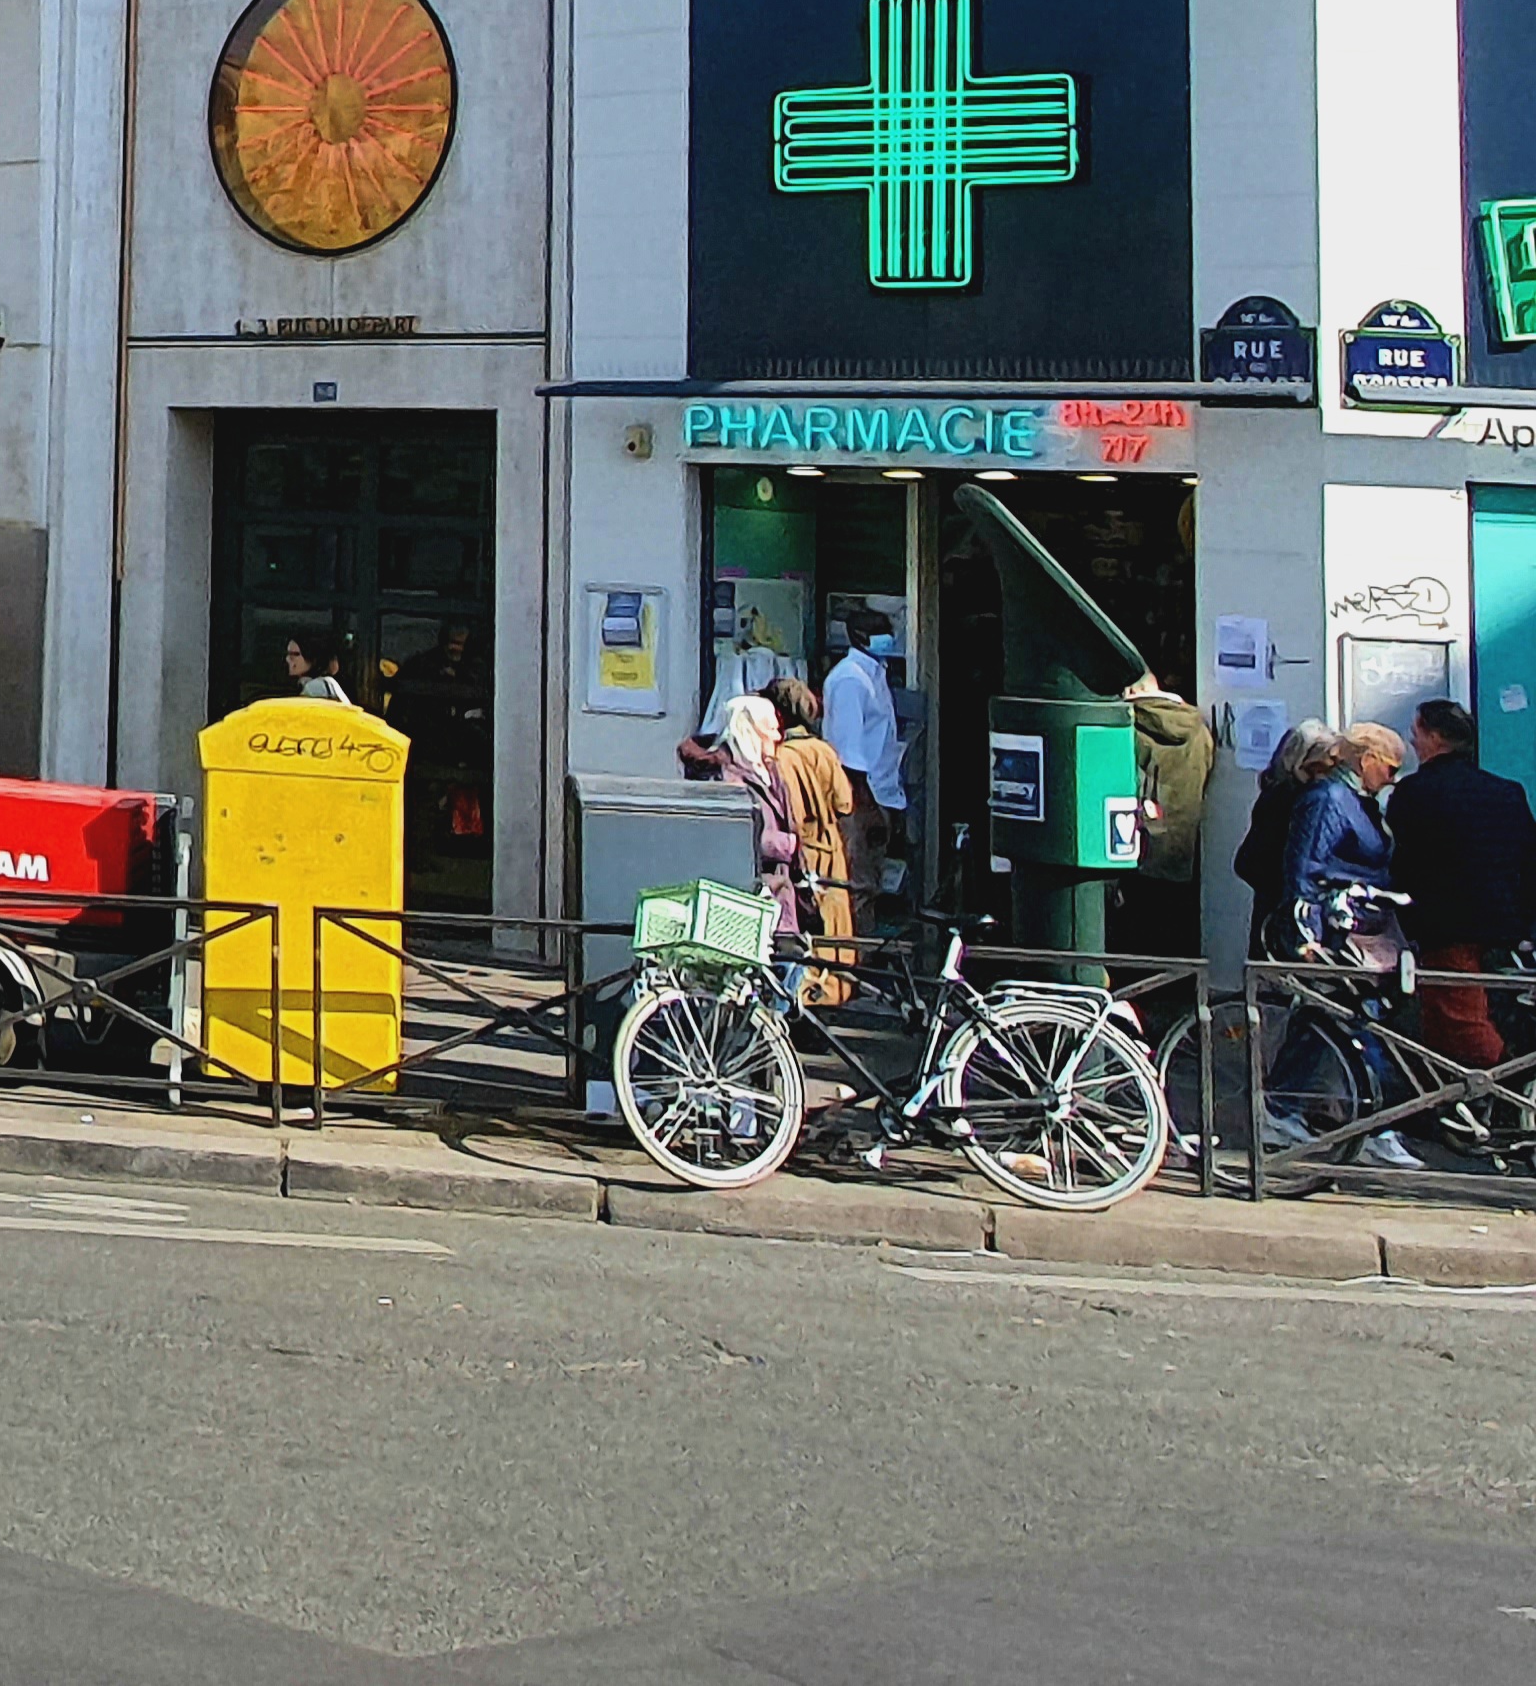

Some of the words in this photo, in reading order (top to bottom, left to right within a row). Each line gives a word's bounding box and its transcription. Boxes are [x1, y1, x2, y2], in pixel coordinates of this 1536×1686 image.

[1233, 340, 1283, 359] RUE
[1378, 348, 1426, 368] RUE
[683, 404, 1034, 457] PHARMACIE
